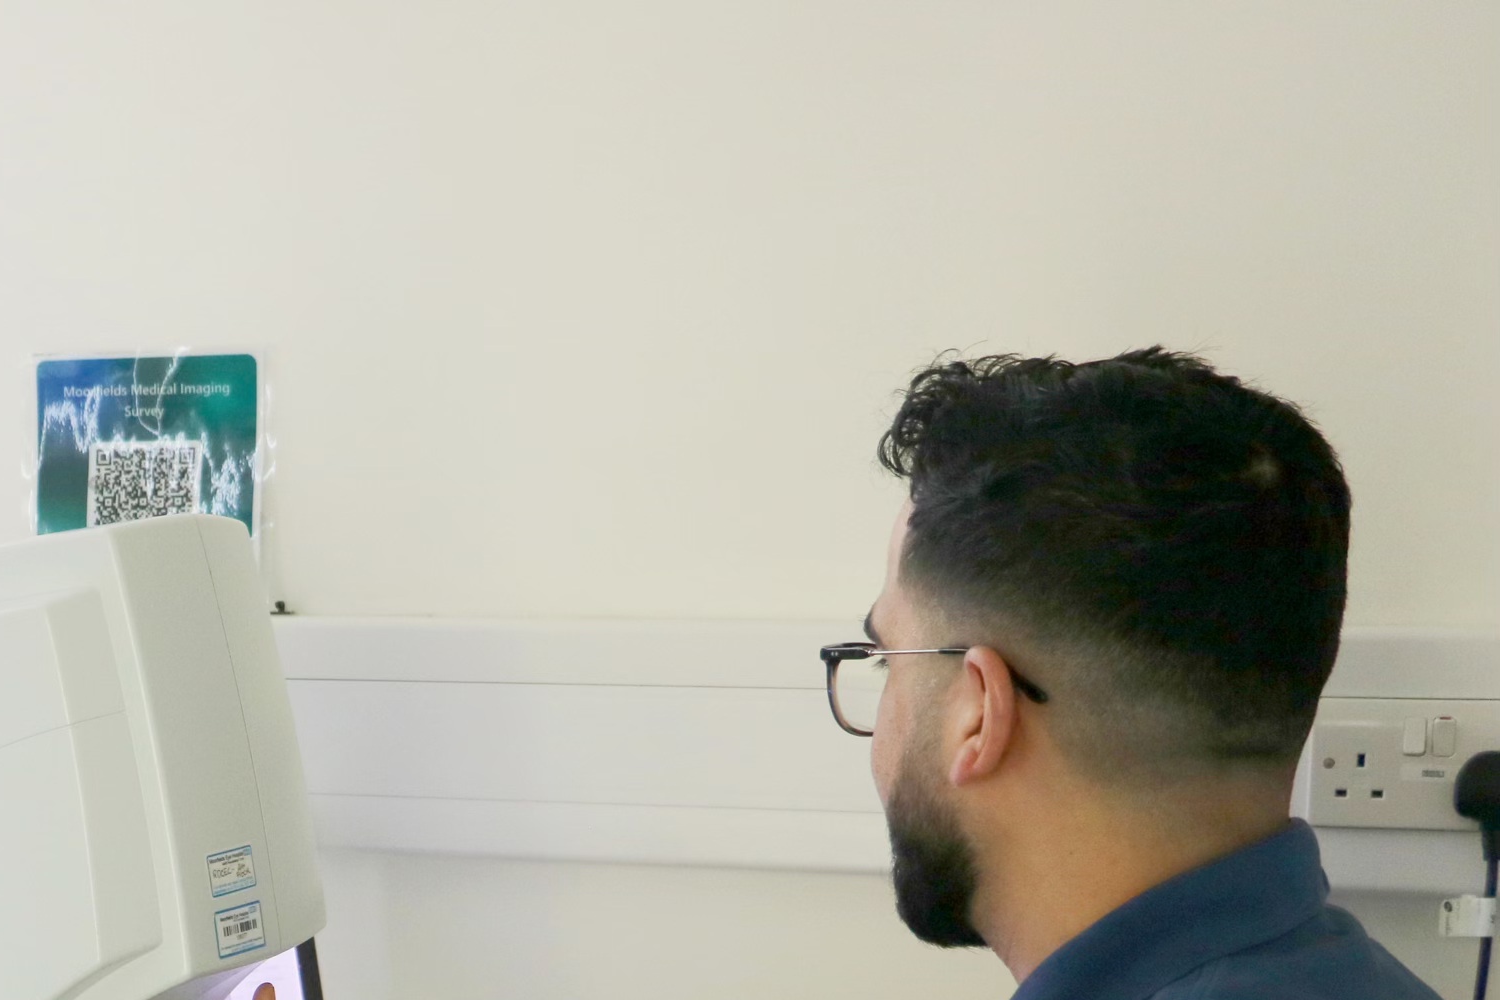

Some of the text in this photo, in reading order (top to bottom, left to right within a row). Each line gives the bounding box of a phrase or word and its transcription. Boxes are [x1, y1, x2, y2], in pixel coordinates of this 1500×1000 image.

[63, 381, 231, 398] Mooields Medical Imaging
[124, 405, 165, 419] Survey
